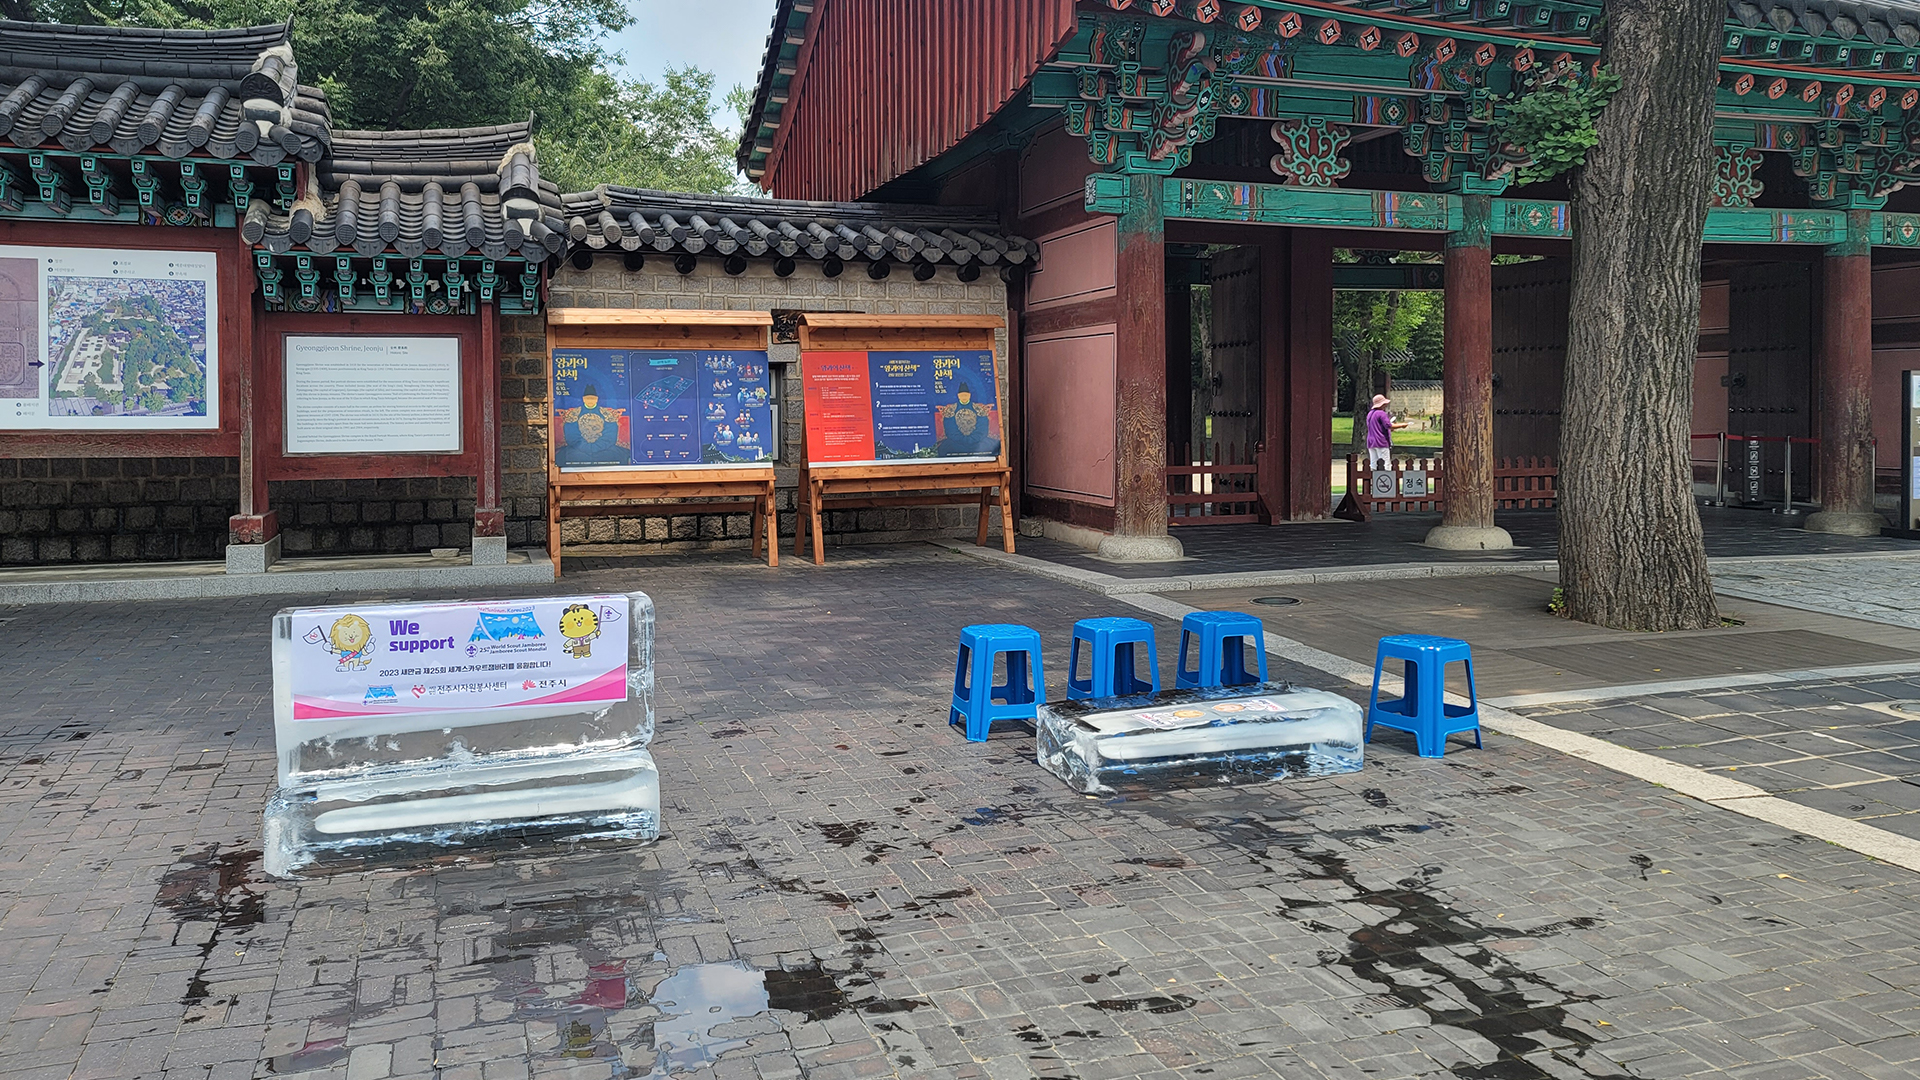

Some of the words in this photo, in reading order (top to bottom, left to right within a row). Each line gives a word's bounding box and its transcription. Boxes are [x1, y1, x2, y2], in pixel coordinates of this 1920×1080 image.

[295, 344, 339, 353] Gyeonggijeon
[340, 344, 363, 352] Shrine,
[363, 345, 384, 353] Jeonju
[389, 619, 420, 636] We
[389, 636, 455, 654] support
[379, 669, 400, 677] 2023
[400, 667, 422, 676] 새만금
[422, 666, 447, 675] 제25회
[447, 662, 515, 674] 세계스카우트잼버리를
[516, 660, 552, 670] 응원합니다!
[437, 681, 508, 695] 전주시자원봉사센터
[538, 679, 567, 689] 전주시
